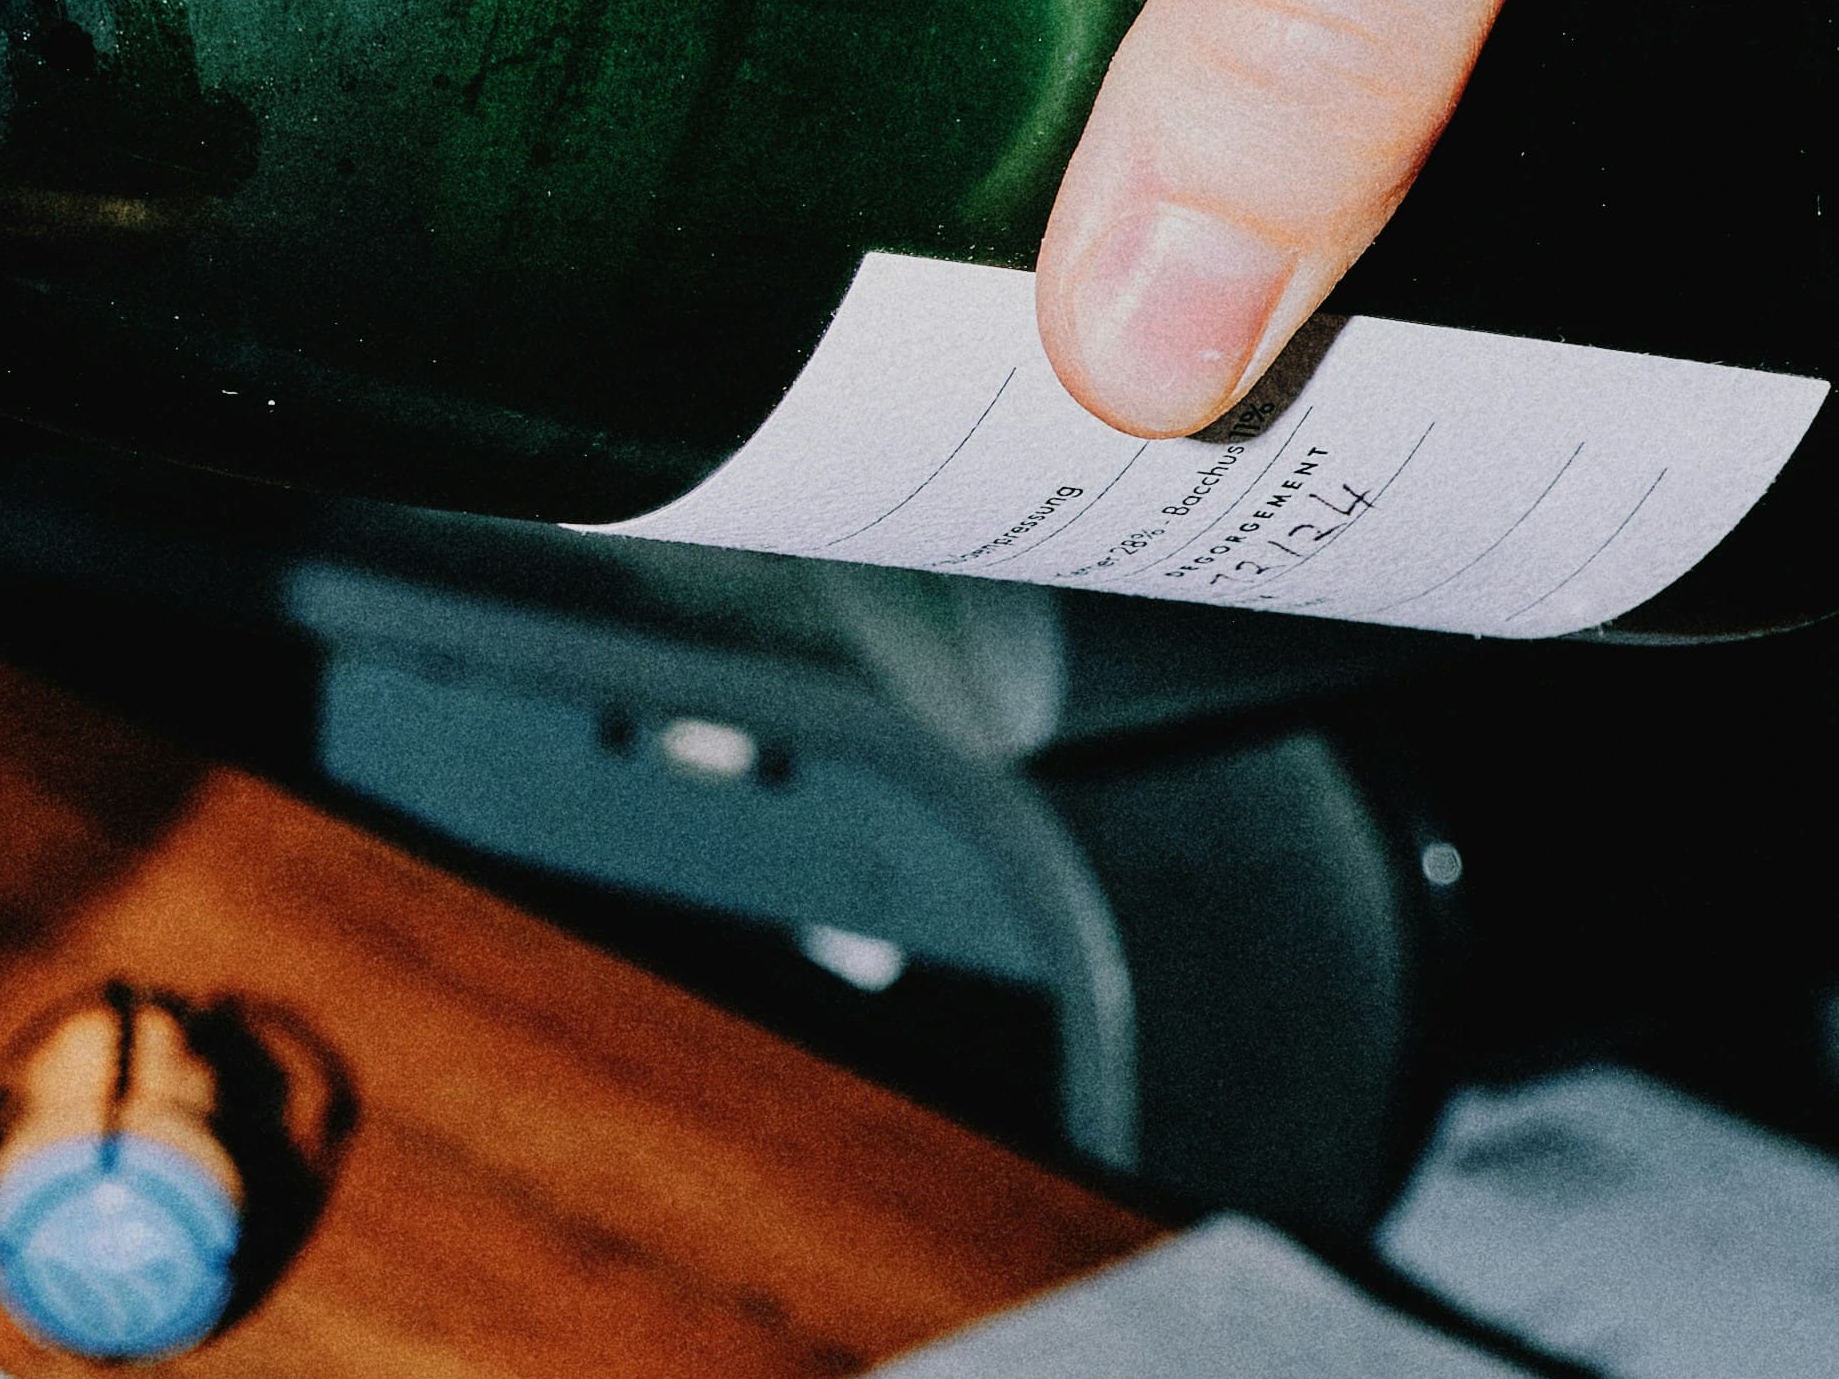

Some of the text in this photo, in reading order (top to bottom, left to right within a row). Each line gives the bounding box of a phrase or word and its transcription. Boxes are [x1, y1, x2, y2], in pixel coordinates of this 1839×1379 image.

[1110, 529, 1165, 556] 28%
[1162, 446, 1244, 515] Bacchus
[1228, 401, 1275, 438] 11%
[1165, 447, 1328, 578] DEGORGEMENT
